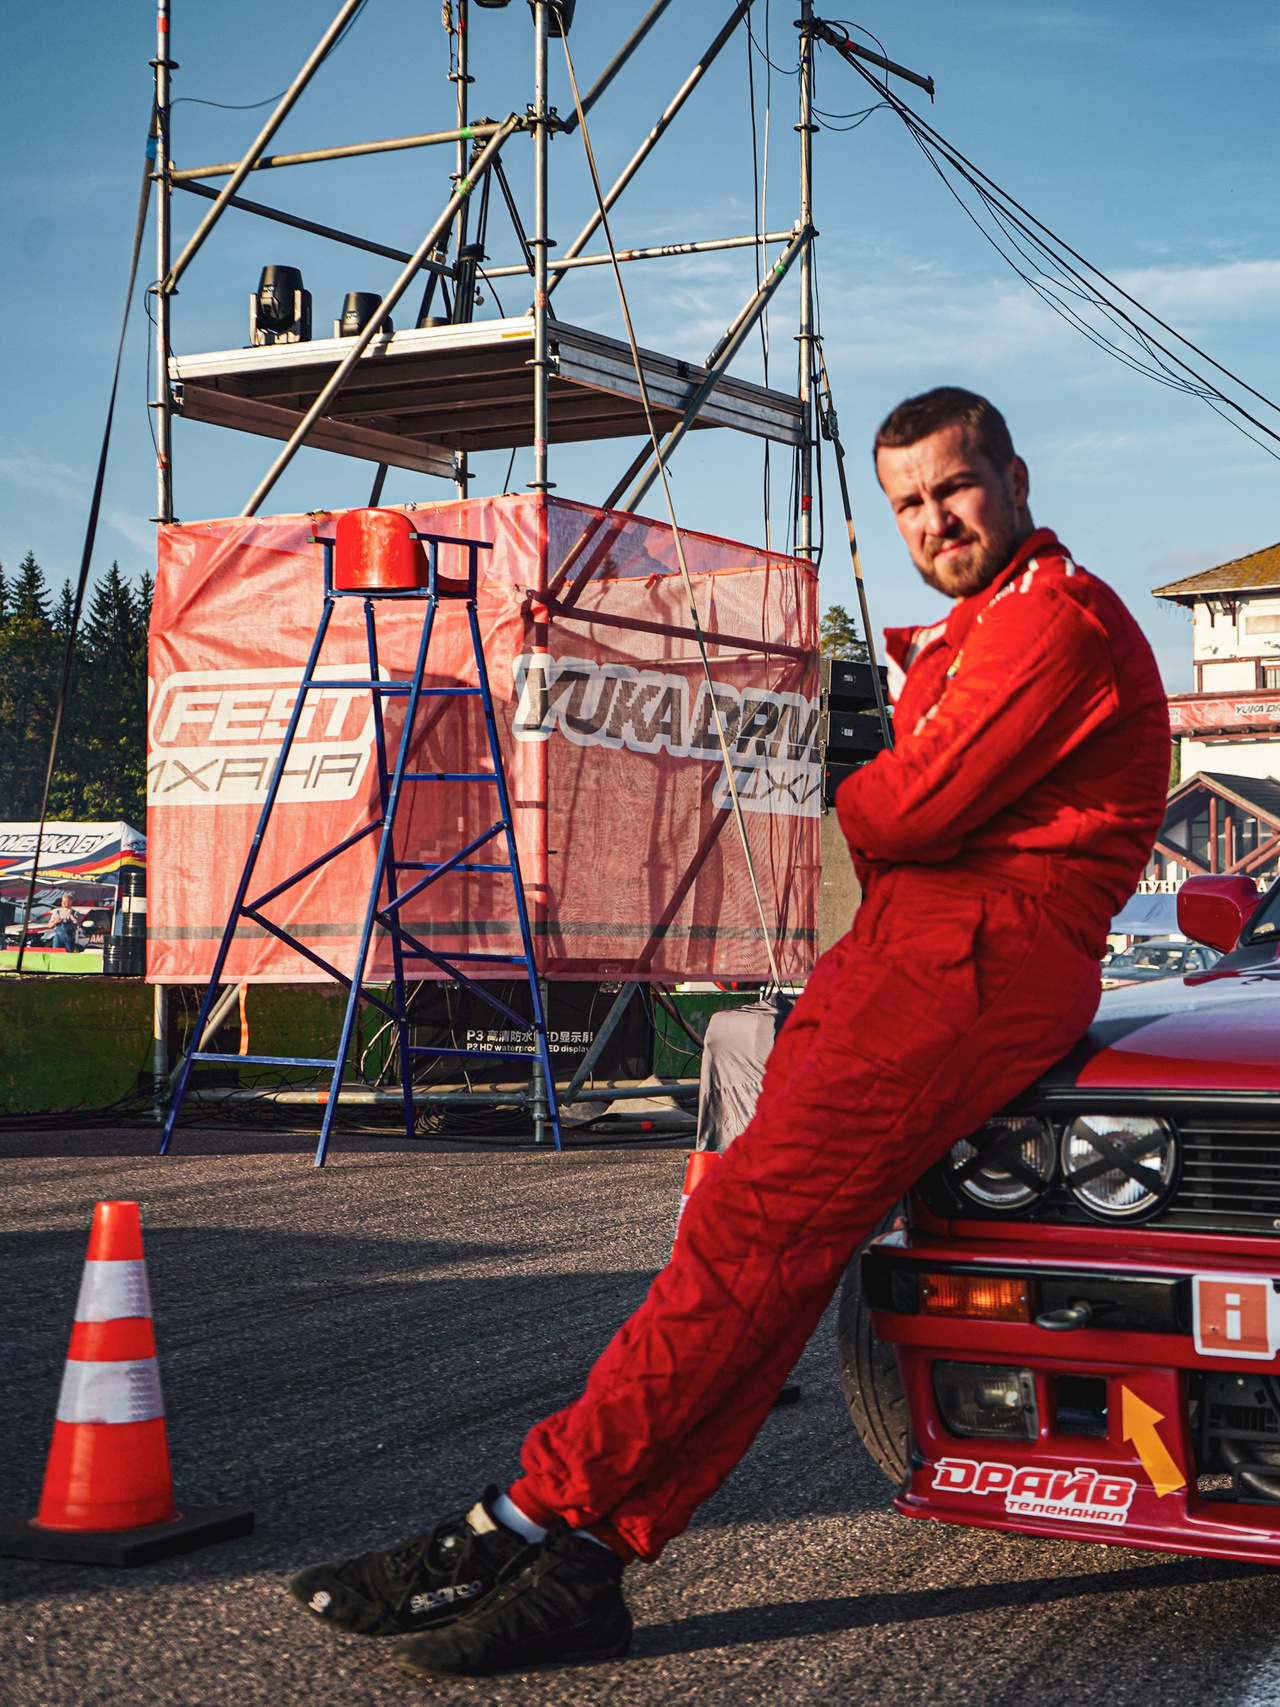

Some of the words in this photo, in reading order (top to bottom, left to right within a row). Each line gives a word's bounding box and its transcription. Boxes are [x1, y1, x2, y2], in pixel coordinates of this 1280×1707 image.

[159, 687, 370, 743] FEST
[522, 667, 682, 747] YUKA
[1236, 705, 1264, 714] YUKA
[466, 1030, 484, 1041] P3
[487, 1029, 593, 1043] 高清防水D显示屏
[480, 1043, 493, 1052] HD
[494, 1044, 536, 1054] waterproo
[934, 1460, 1133, 1507] ДРАЙВ
[410, 1580, 482, 1614] sparco
